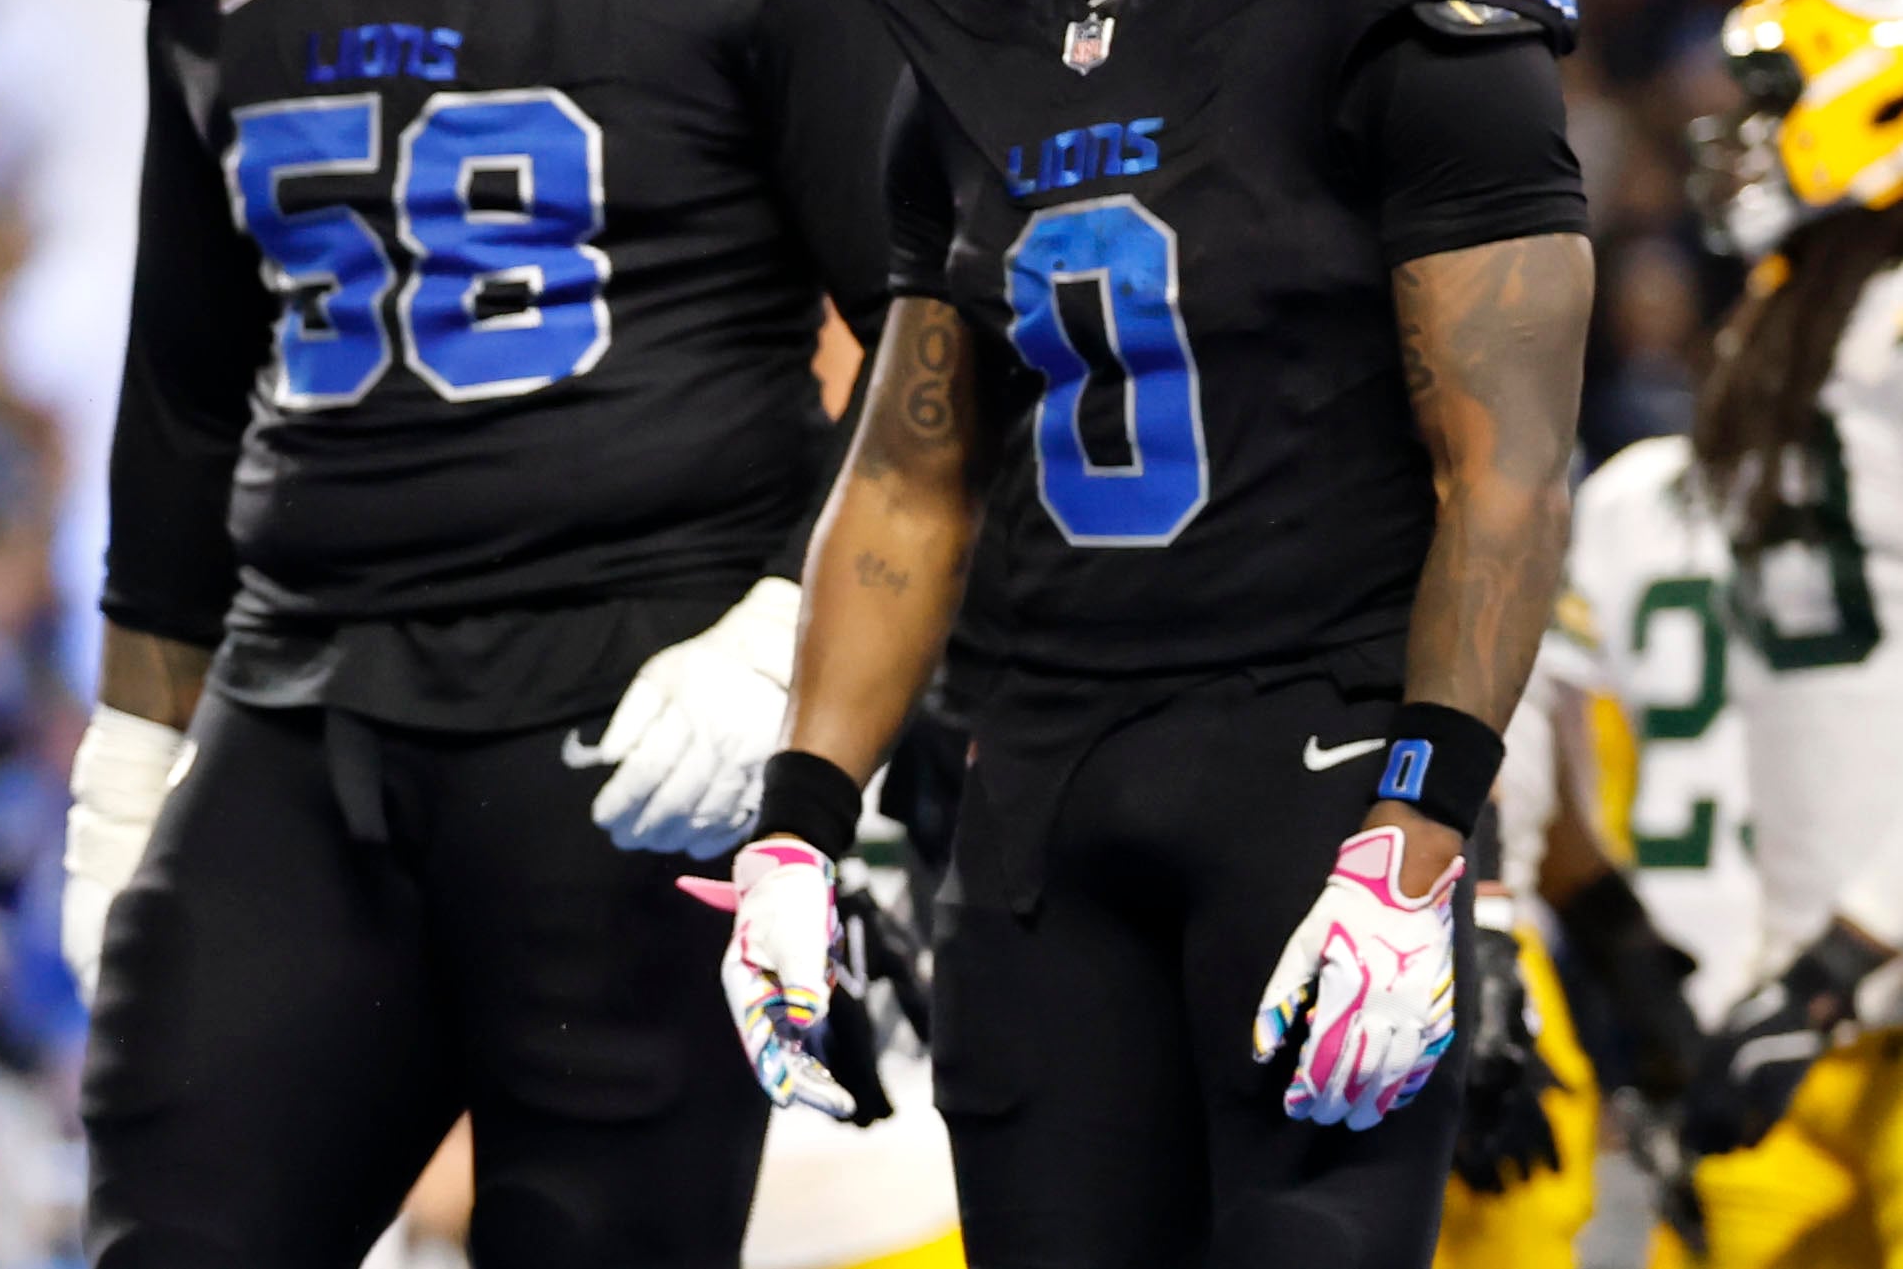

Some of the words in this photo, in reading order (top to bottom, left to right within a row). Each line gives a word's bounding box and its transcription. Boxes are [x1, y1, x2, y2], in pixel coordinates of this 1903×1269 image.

[306, 23, 464, 82] LIONS
[221, 86, 612, 412] 58
[1006, 117, 1165, 197] LIONS
[1004, 193, 1210, 548] 0
[1378, 737, 1434, 802] 0
[1632, 577, 1755, 869] 2
